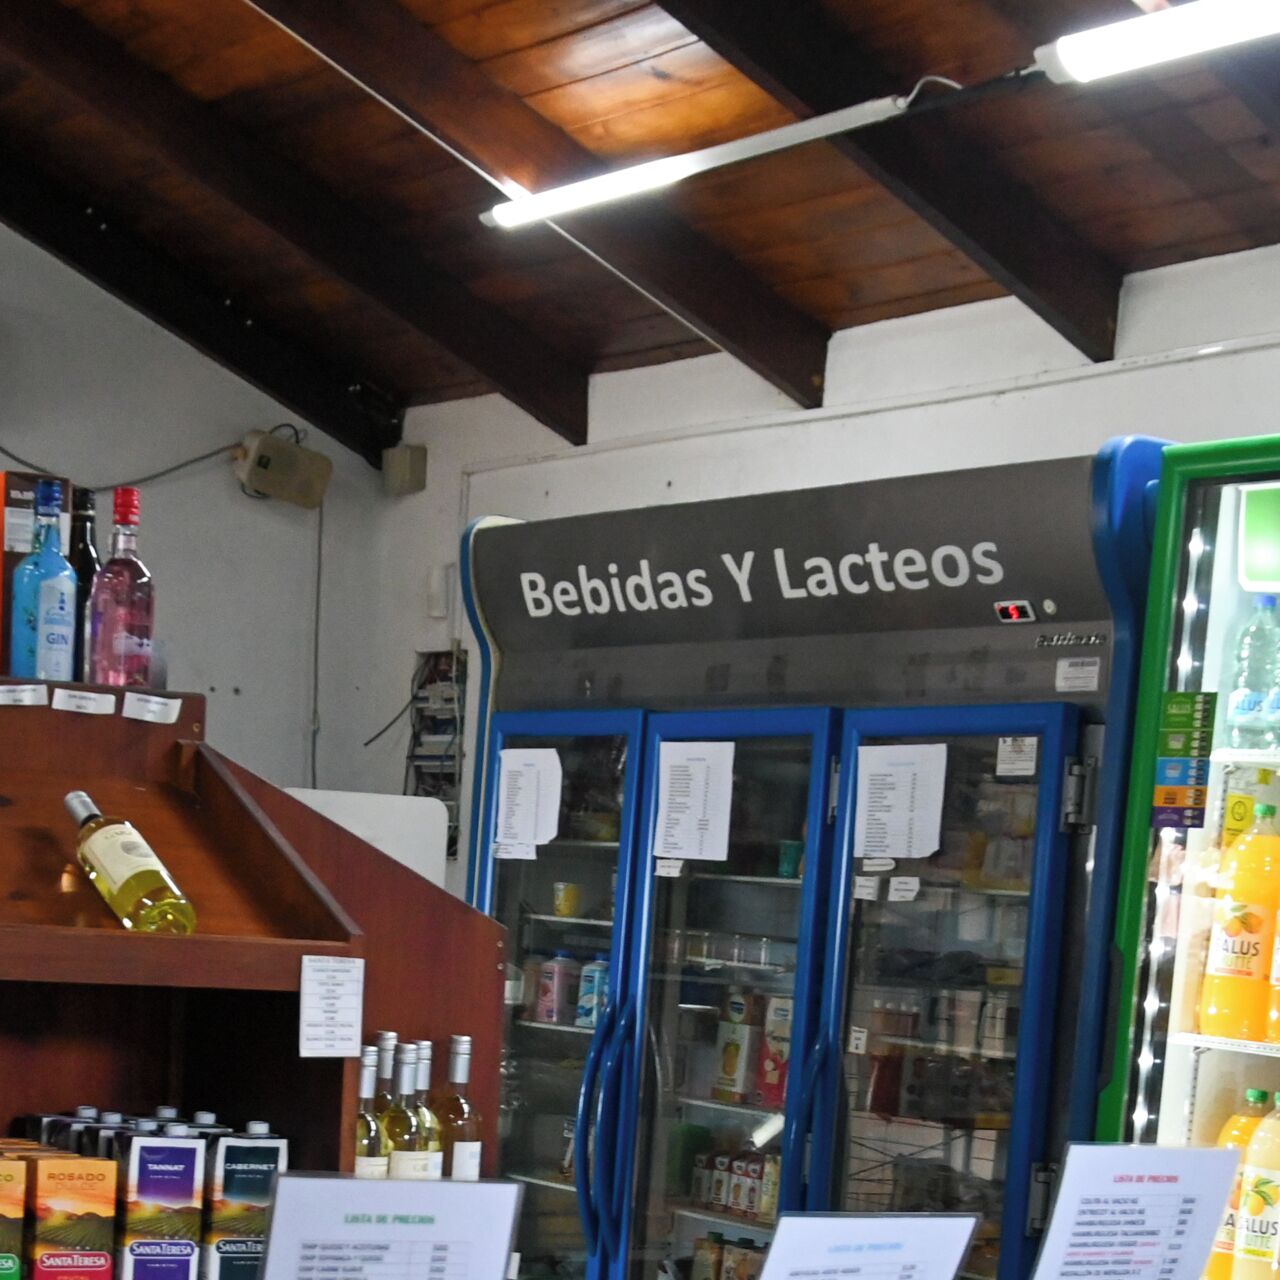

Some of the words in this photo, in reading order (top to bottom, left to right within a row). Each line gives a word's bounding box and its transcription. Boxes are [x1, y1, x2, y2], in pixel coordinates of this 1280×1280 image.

[520, 559, 713, 617] Bebidas
[721, 551, 755, 602] Y
[773, 541, 1004, 598] Lacteos
[46, 632, 69, 645] GIN
[146, 1163, 186, 1171] TANNAT
[47, 1172, 106, 1182] ROSADO
